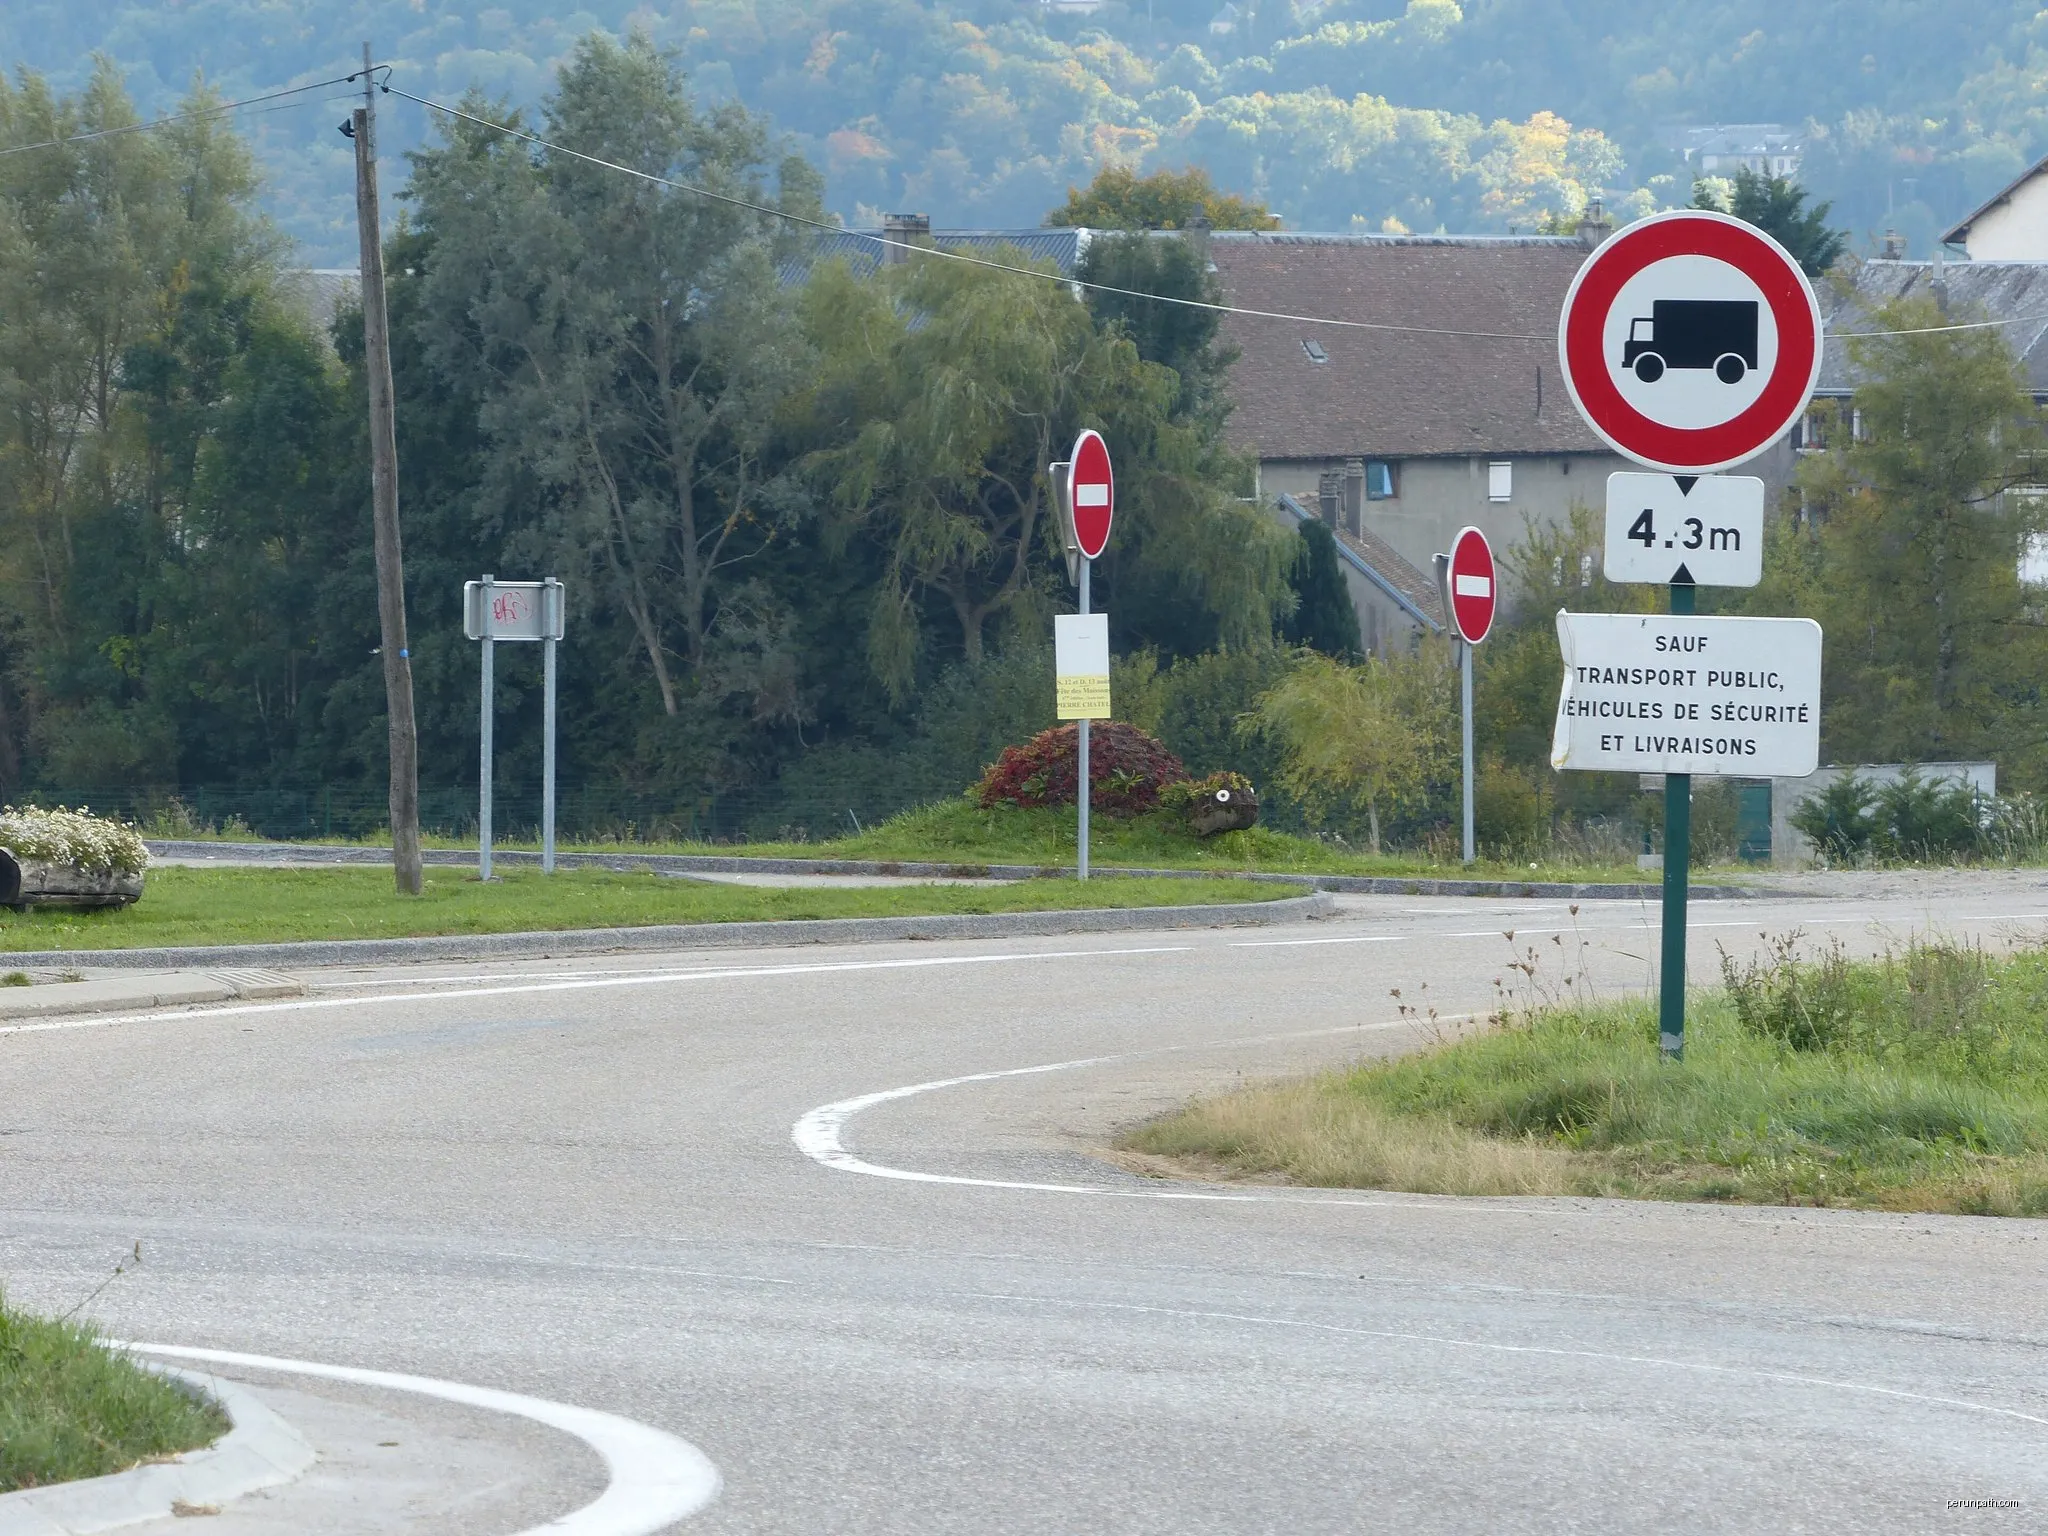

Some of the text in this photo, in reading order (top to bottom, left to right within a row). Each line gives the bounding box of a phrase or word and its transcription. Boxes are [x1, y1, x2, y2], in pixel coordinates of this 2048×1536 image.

[1655, 635, 1708, 653] SAUF
[1577, 667, 1785, 692] TRANSPORT PUBLIC,
[1674, 703, 1699, 721] DE
[1711, 701, 1809, 723] SÉCURITÉ
[1601, 735, 1756, 755] ET LIVRAISONS
